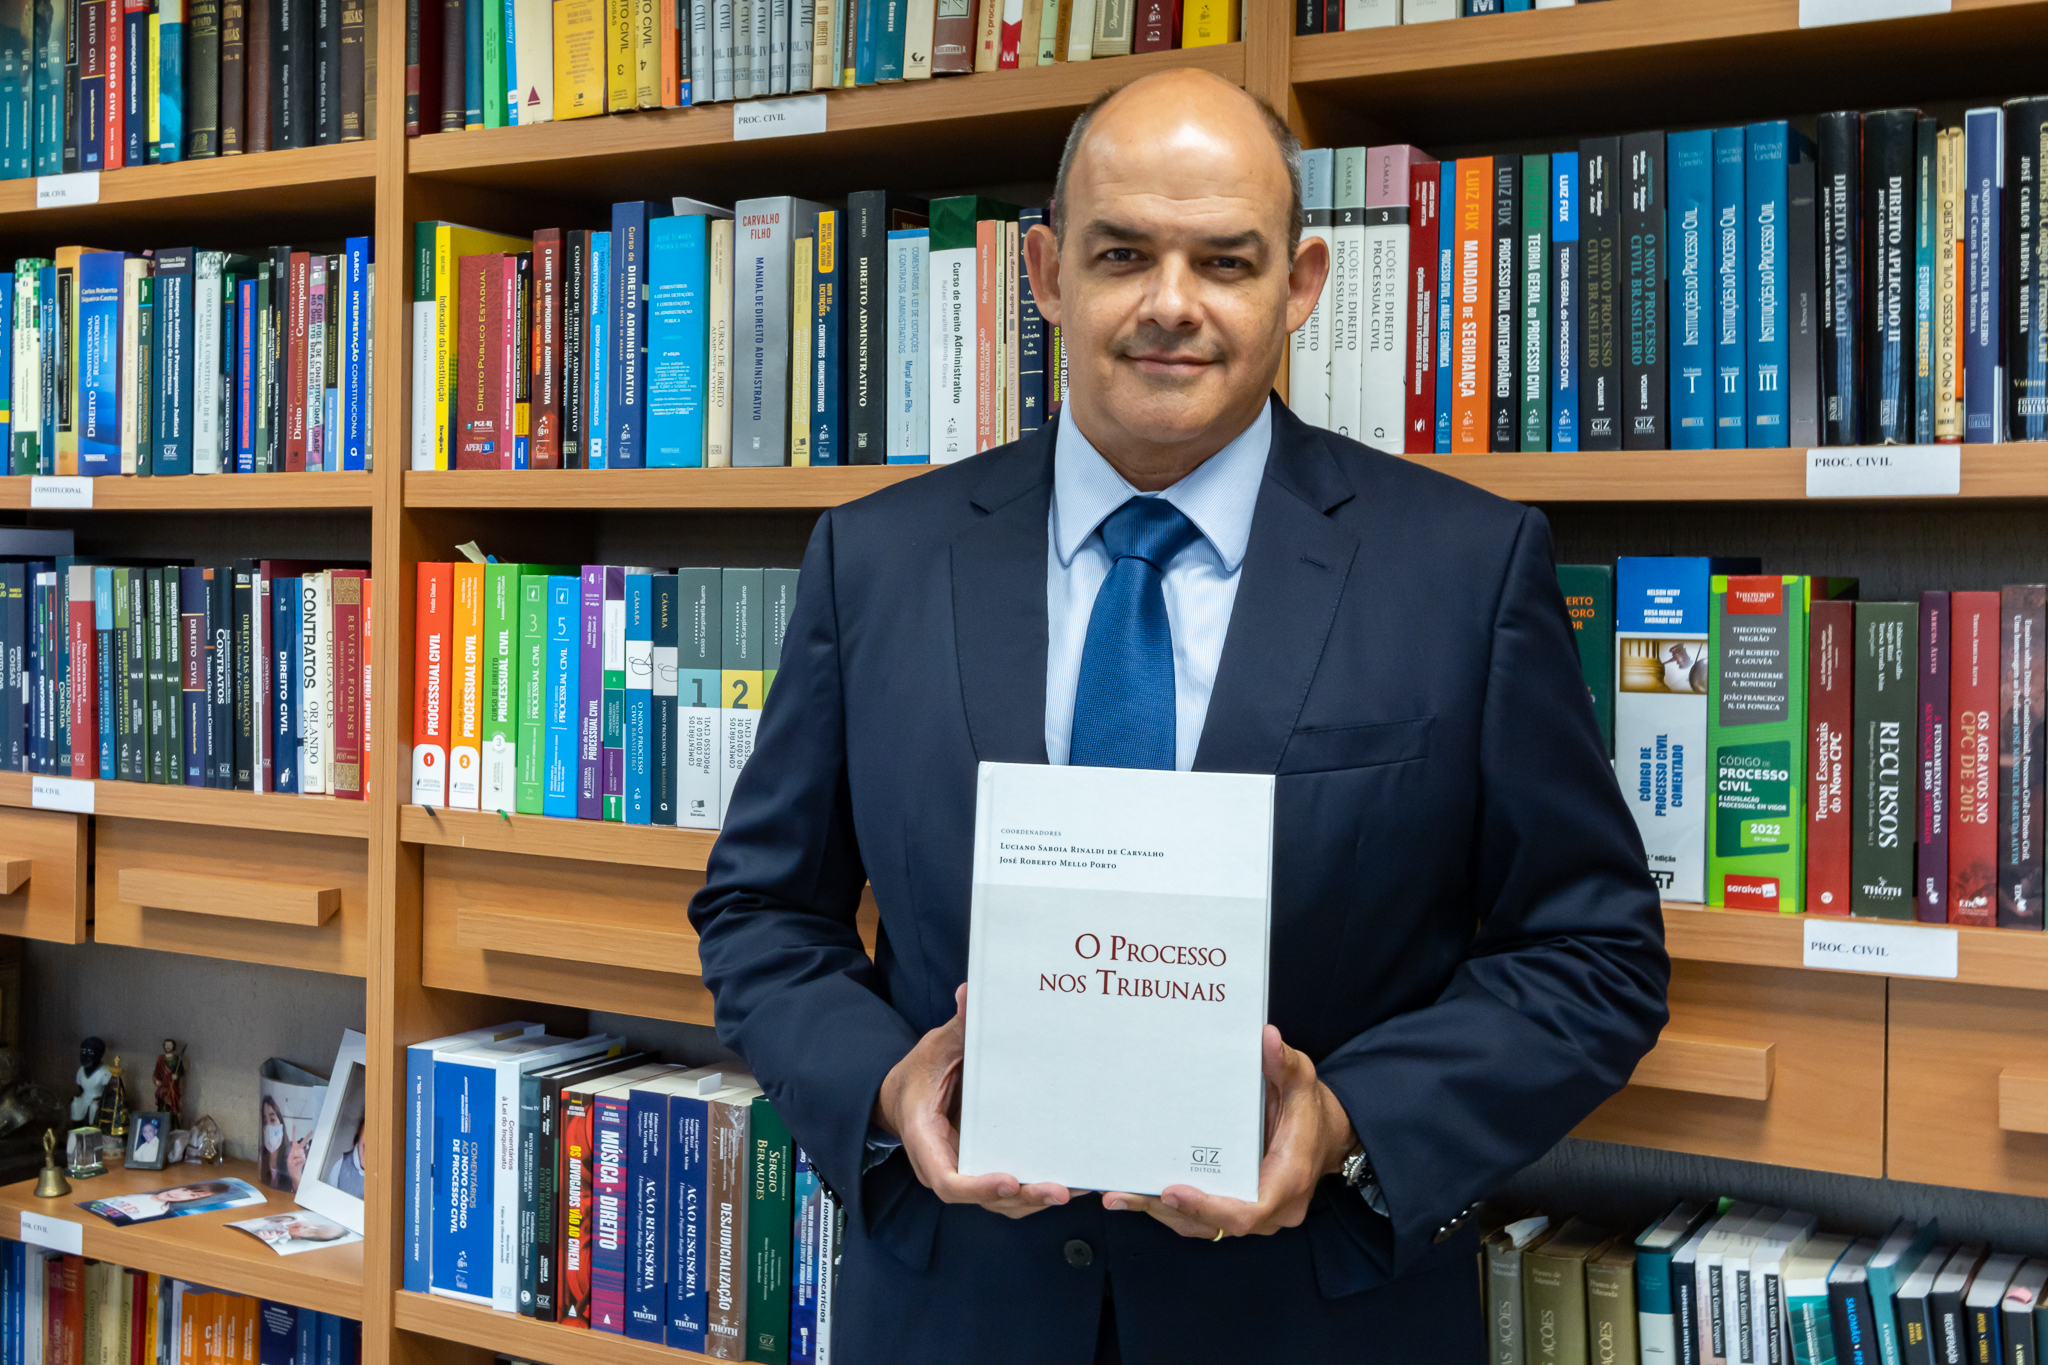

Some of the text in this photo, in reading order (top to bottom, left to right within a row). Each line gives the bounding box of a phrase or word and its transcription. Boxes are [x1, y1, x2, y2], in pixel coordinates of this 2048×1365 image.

[620, 22, 629, 54] CIVIL
[642, 17, 652, 49] CIVIL
[109, 27, 120, 123] DO CÓDIGO CIVIL
[738, 113, 786, 125] PROC. CIVIL
[743, 213, 780, 227] CARVALHO
[750, 228, 771, 240] FILHO
[1888, 177, 1902, 241] DIREITO
[545, 283, 551, 293] DA
[1371, 240, 1382, 353] PROCESSUAL CIVIL
[1384, 240, 1397, 352] LIÇÕES DE DIREITO
[1459, 170, 1479, 398] LUIZ FUX MANDADO DE SEGURANÇA
[1888, 247, 1901, 326] APLICADO
[351, 291, 361, 361] INTERPRETAÇÃO
[476, 324, 486, 369] PÚBLICO
[625, 226, 637, 406] Curso de DIREITO ADMINISTRATIVO
[752, 257, 764, 421] MANUAL DE DIREITO ADMINISTRATIVO
[858, 257, 869, 407] DIREITO ADMINISTRATIVO
[952, 263, 963, 404] Curso de Direito Administrativo
[1497, 238, 1512, 398] PROCESSO CIVIL CONTEMPORÂNEO
[1527, 234, 1541, 402] TEORIA GERAL DO PROCESSO CIVIL
[1918, 266, 1930, 378] ESTUDOS e PARECERES
[294, 263, 306, 440] Direito Constitucional Contemporâneo
[435, 295, 447, 403] Indexador da Constituição
[543, 346, 551, 406] ADMINISTRATIVA
[351, 364, 359, 440] CONSTITUCIONAL
[477, 371, 485, 412] DIREITO
[34, 486, 82, 494] CONSTITUCIONAL
[1814, 456, 1893, 467] PROC. CIVIL
[634, 591, 642, 627] CÂMARA
[661, 593, 670, 629] CÂMARA
[216, 628, 226, 706] CONTRATOS
[279, 650, 289, 736] DIREITO CIVIL
[304, 587, 319, 765] CONTRATOS ORLANDO
[347, 614, 356, 740] REVISTA FORENSE
[427, 633, 441, 736] PROCESSUAL CIVIL
[463, 634, 477, 738] PROCESSUAL CIVIL
[691, 678, 706, 708] 1
[732, 679, 749, 710] 2
[425, 756, 434, 765] 1
[460, 757, 470, 767] 2
[687, 716, 696, 767] COMENTÁRIOS
[695, 716, 704, 768] AO CÓDIGO DE
[703, 716, 711, 775] PROCESSO CIVIL
[1719, 755, 1760, 768] CÓDIGO
[1961, 711, 1976, 824] CPC DE 2015
[1976, 710, 1989, 824] OS AGRAVOS NO
[46, 787, 61, 795] CIVIL
[1638, 747, 1652, 802] CÓDIGO DE
[1655, 733, 1668, 817] PROCESSO CIVIL
[1670, 745, 1684, 808] COMENTADO
[1719, 767, 1789, 781] PROCESSO
[1719, 780, 1753, 793] CIVIL
[1878, 721, 1900, 849] RECURSOS
[999, 841, 1036, 852] LUCIANO
[1037, 843, 1068, 853] SABOIA
[1070, 844, 1104, 855] RINALDI
[1120, 847, 1164, 858] CARVALHO
[1001, 827, 1063, 838] COORDENADORES
[1750, 823, 1781, 835] 2022
[999, 855, 1117, 870] JOSÉ ROBERTO MELLO PORTO
[1727, 883, 1762, 894] saraiva
[1075, 933, 1101, 960] O
[1811, 941, 1889, 957] PROC. CIVIL
[449, 1138, 460, 1235] DE PROCESSO CIVIL
[458, 1140, 470, 1230] AO NOVO CÓDIGO
[469, 1142, 479, 1210] COMENTÁRIOS
[599, 1130, 623, 1251] MÚSICA DIREITO
[755, 1139, 769, 1200] BERMUDES
[767, 1150, 781, 1193] SERGIO
[1190, 1165, 1222, 1175] EDITORA
[567, 1145, 583, 1271] OS ADVOGADOS VÃO AO CINEMA
[643, 1177, 657, 1291] AÇÃO RESCISÓRIA
[716, 1202, 733, 1312] DESJUDICIALIZAÇÃO
[819, 1201, 832, 1324] HONORÁRIOS ADVOCATÍCIOS
[710, 1323, 739, 1337] THOTH
[1943, 1312, 1958, 1364] RECUPERAÇÃO
